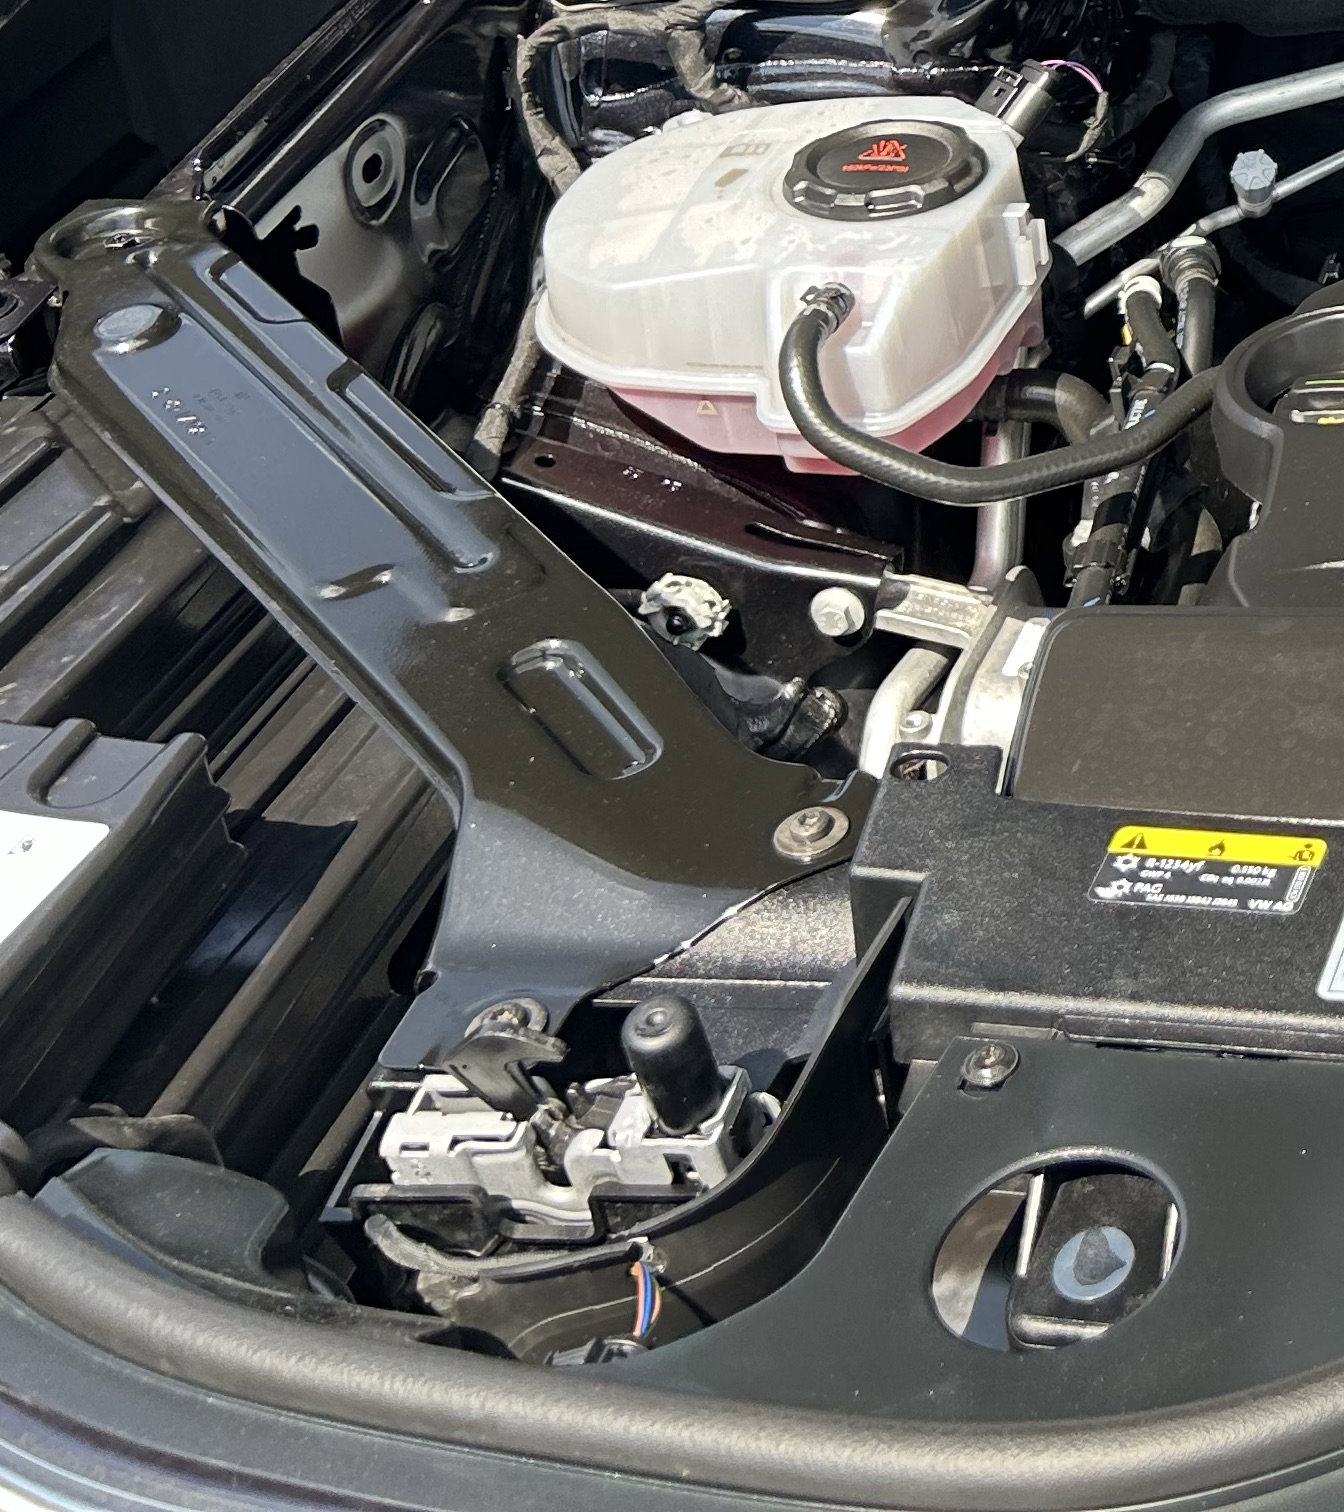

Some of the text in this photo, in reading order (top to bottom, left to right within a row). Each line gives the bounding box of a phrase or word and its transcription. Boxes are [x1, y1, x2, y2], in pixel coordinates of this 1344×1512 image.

[1145, 857, 1205, 873] R-1234yf
[1262, 866, 1277, 878] kg
[1133, 882, 1163, 894] PAG
[1247, 898, 1273, 909] VW
